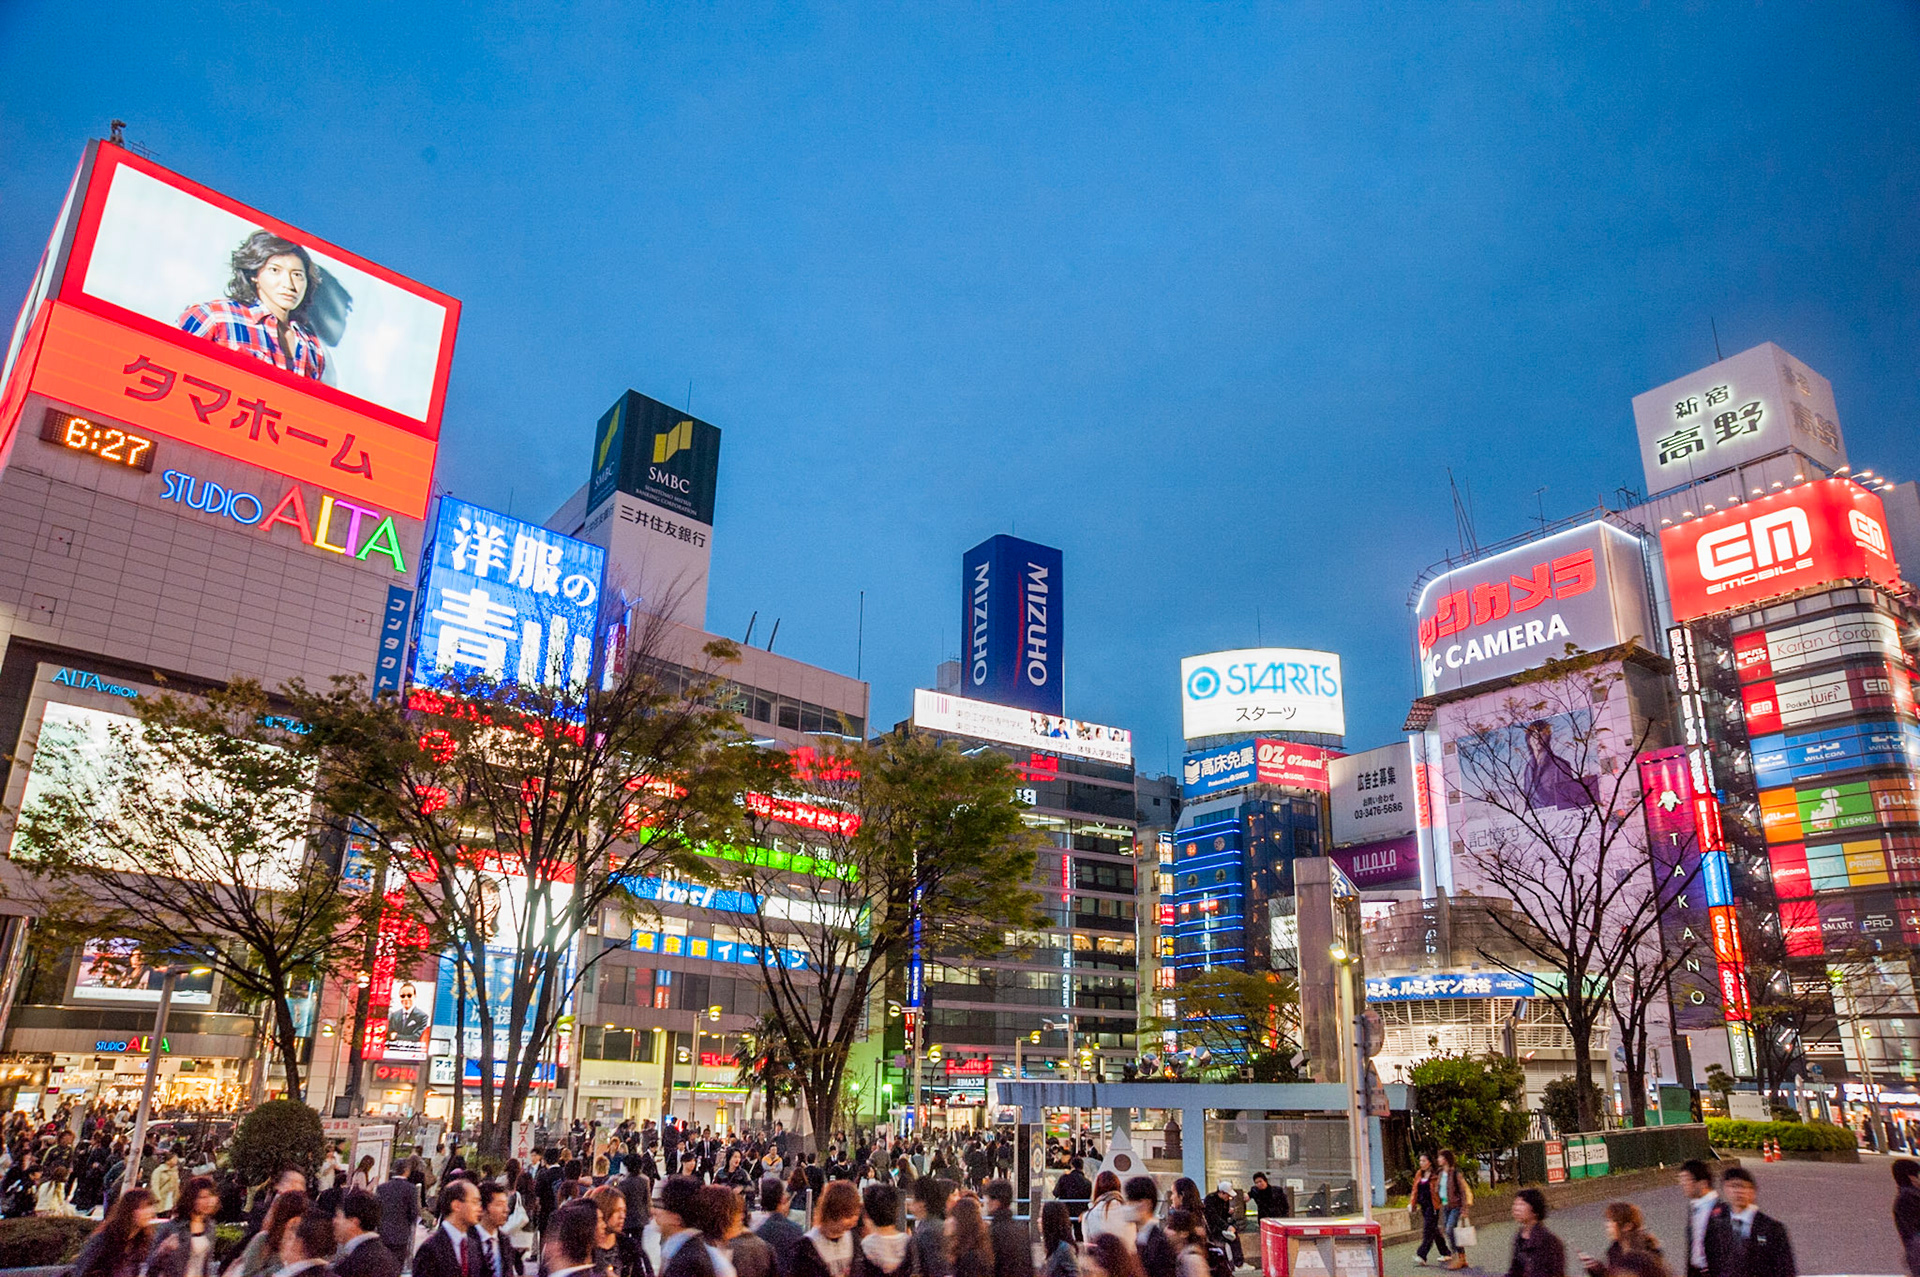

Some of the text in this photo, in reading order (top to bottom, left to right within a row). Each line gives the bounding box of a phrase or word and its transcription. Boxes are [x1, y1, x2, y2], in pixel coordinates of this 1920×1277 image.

[124, 355, 373, 480] タマホーム
[1675, 385, 1730, 419] 新宿
[64, 417, 151, 465] 6:27
[1657, 401, 1764, 465] 高野
[648, 466, 690, 494] SMBC
[160, 469, 407, 573] STUDIO ALTA
[620, 504, 706, 548] 三井住友銀行
[452, 516, 596, 607] 洋服の
[1706, 557, 1814, 595] EMOBILE
[973, 561, 990, 686] MIZUHO
[1027, 561, 1049, 687] MIZUHO
[377, 598, 407, 690] コンタクト
[432, 588, 592, 704] 青山
[1445, 613, 1570, 669] CAMERA
[1776, 635, 1824, 657] Karan
[1226, 662, 1338, 697] STARTS
[1236, 706, 1297, 723] スターツ
[1786, 700, 1811, 710] Pocket
[1200, 746, 1255, 778] 高床免震
[1258, 744, 1286, 764] OZ
[1804, 750, 1846, 762] WILLCOM
[1357, 766, 1397, 792] 広告主募集
[1354, 802, 1403, 820] 03-3476-5686
[1363, 793, 1395, 807] お問い合わせ
[1840, 816, 1872, 826] LISMO!
[1353, 849, 1397, 873] NUOVO
[1849, 859, 1882, 869] PRIME
[1669, 832, 1706, 1005] TAKANO
[1822, 921, 1854, 931] SMART
[1862, 919, 1893, 928] PRO
[636, 932, 806, 968] 英会話イーオン
[96, 1036, 171, 1053] STUDIO ALA
[1733, 1035, 1747, 1075] SoftBank
